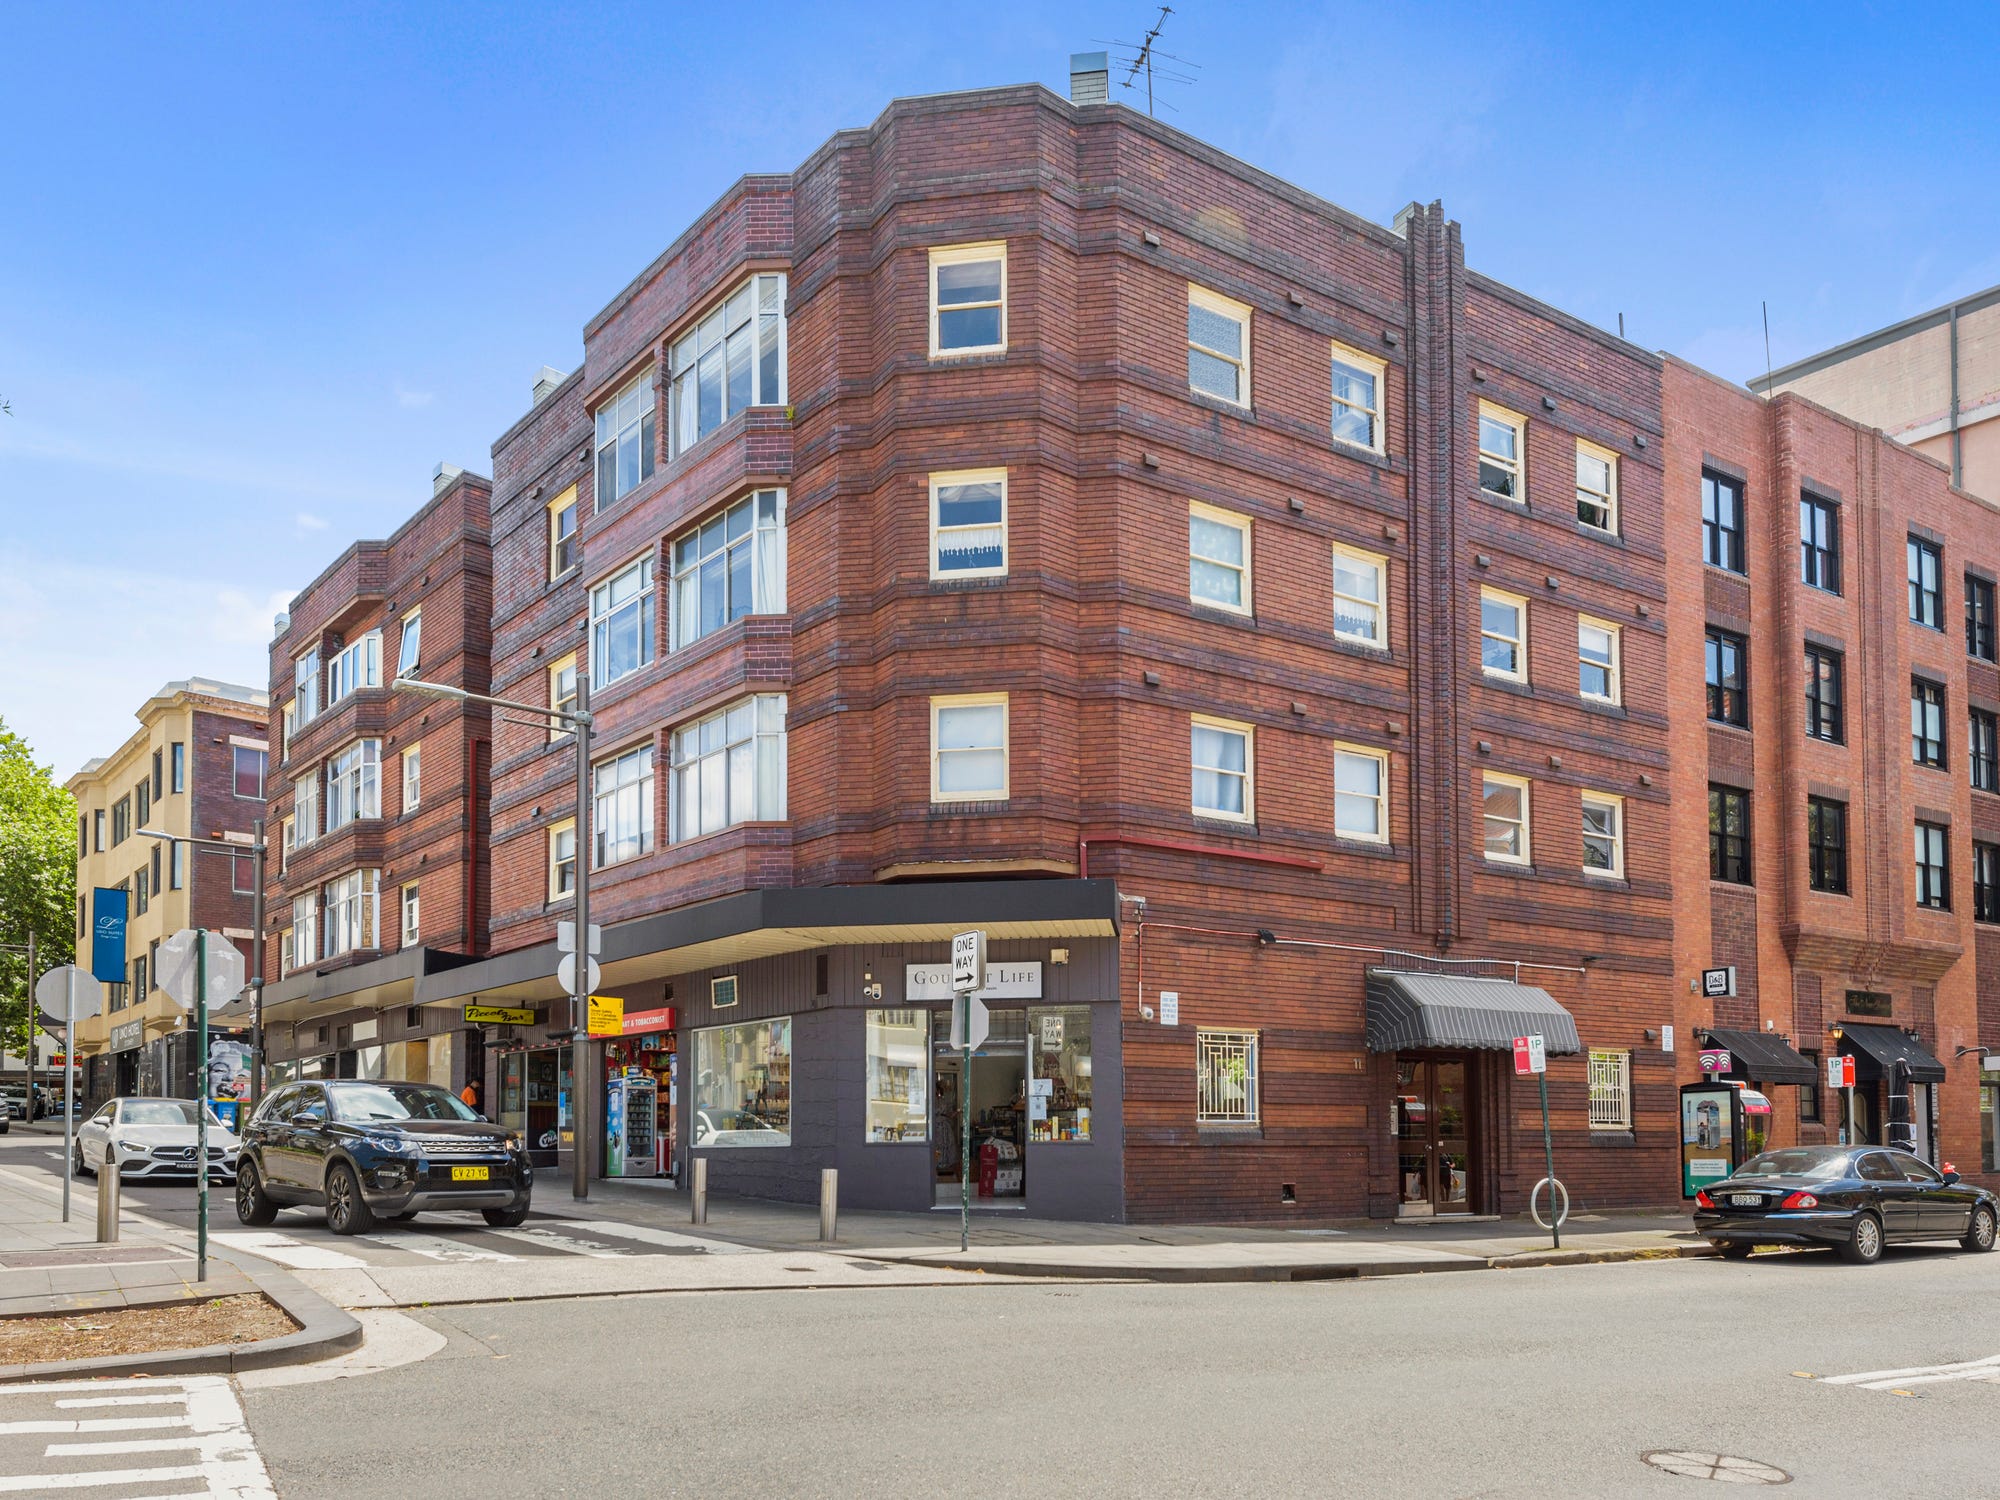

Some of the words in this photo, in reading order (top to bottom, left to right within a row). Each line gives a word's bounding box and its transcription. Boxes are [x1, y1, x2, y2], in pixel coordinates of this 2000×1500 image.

[956, 937, 975, 953] ONE
[955, 955, 975, 970] WAY
[914, 970, 993, 984] GOUT
[1000, 969, 1034, 983] LIFE
[467, 1008, 508, 1018] Piccolo
[502, 1014, 524, 1022] Bar
[635, 1015, 665, 1026] TOBACCONIST
[1531, 1040, 1541, 1048] 1P
[1353, 1058, 1362, 1070] 11
[1831, 1061, 1841, 1069] 1P
[466, 1169, 475, 1178] 27
